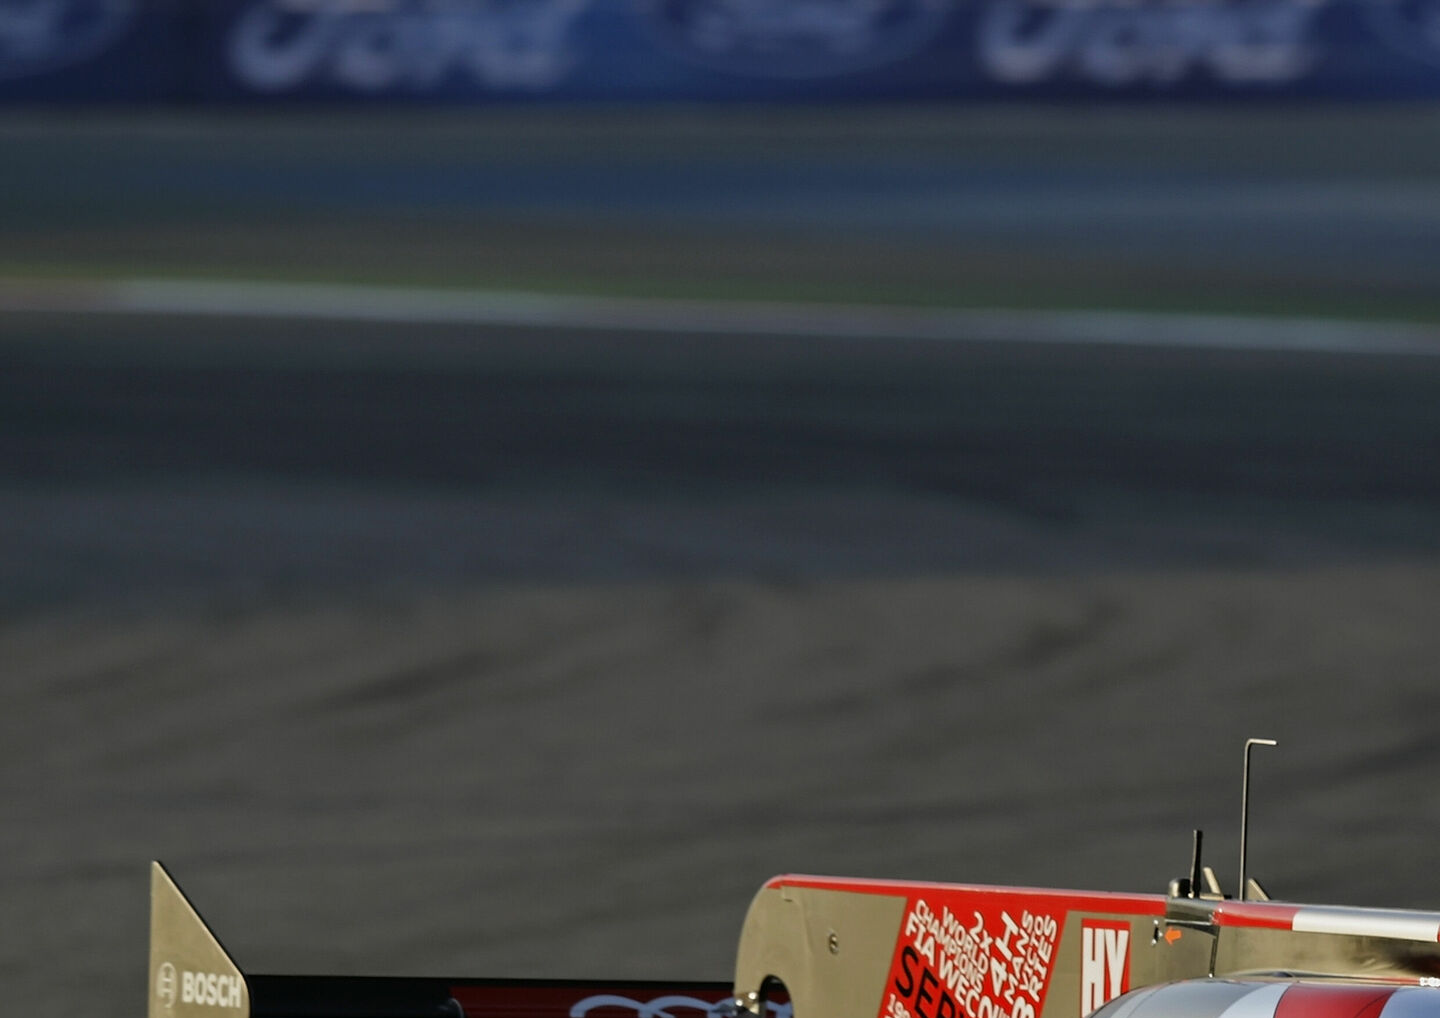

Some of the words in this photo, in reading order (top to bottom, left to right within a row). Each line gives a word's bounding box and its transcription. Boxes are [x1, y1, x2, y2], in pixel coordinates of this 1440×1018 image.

[905, 911, 936, 967] FIA
[939, 950, 980, 1018] WEC
[916, 899, 983, 993] CHAMPIONS
[943, 906, 988, 974] WORLD
[1004, 910, 1033, 1005] MANS
[1080, 927, 1130, 1018] HY
[181, 971, 241, 1008] BOSCH
